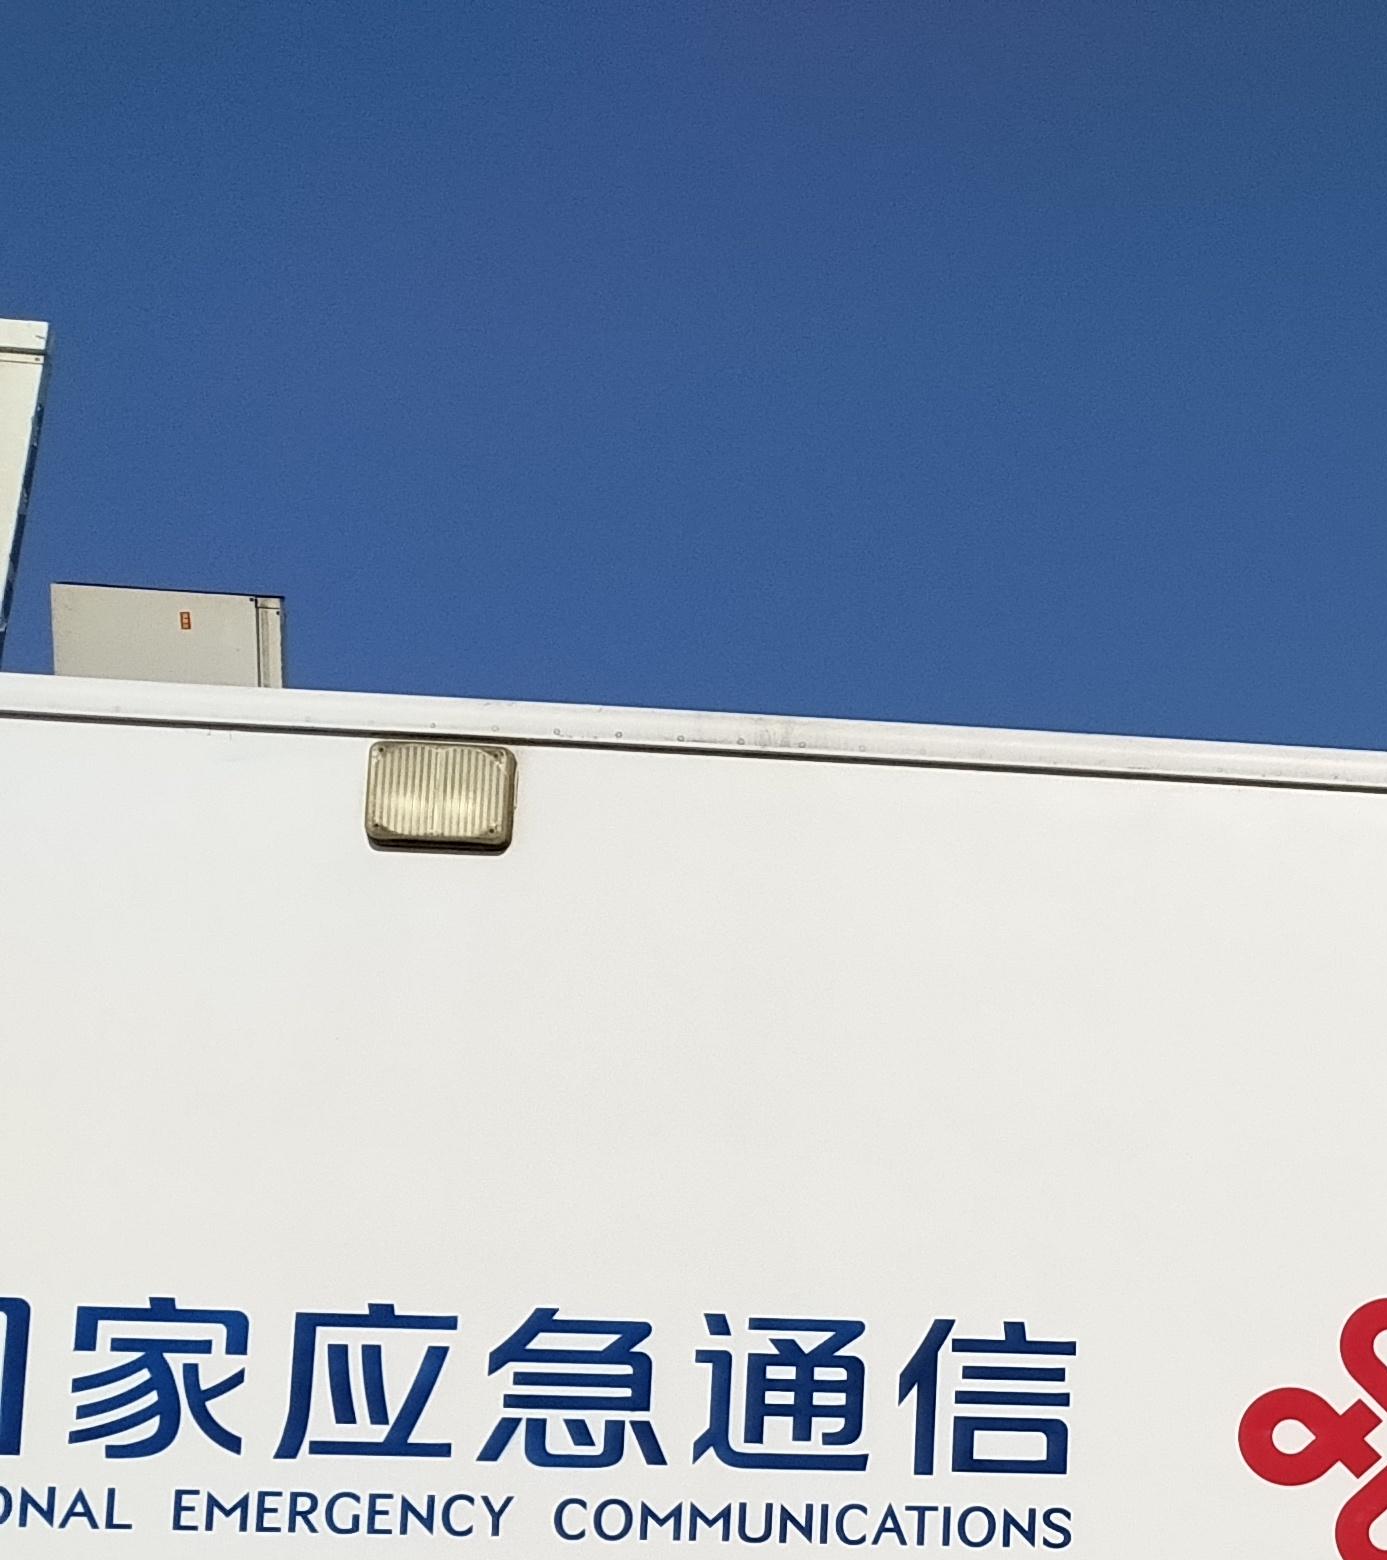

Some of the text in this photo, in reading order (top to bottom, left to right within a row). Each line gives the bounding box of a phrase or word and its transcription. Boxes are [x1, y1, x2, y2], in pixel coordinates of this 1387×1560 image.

[0, 1297, 1076, 1475] 家应急通信
[173, 1490, 513, 1536] EMERGENCY
[554, 1498, 1071, 1549] COMMUNICATIONS
